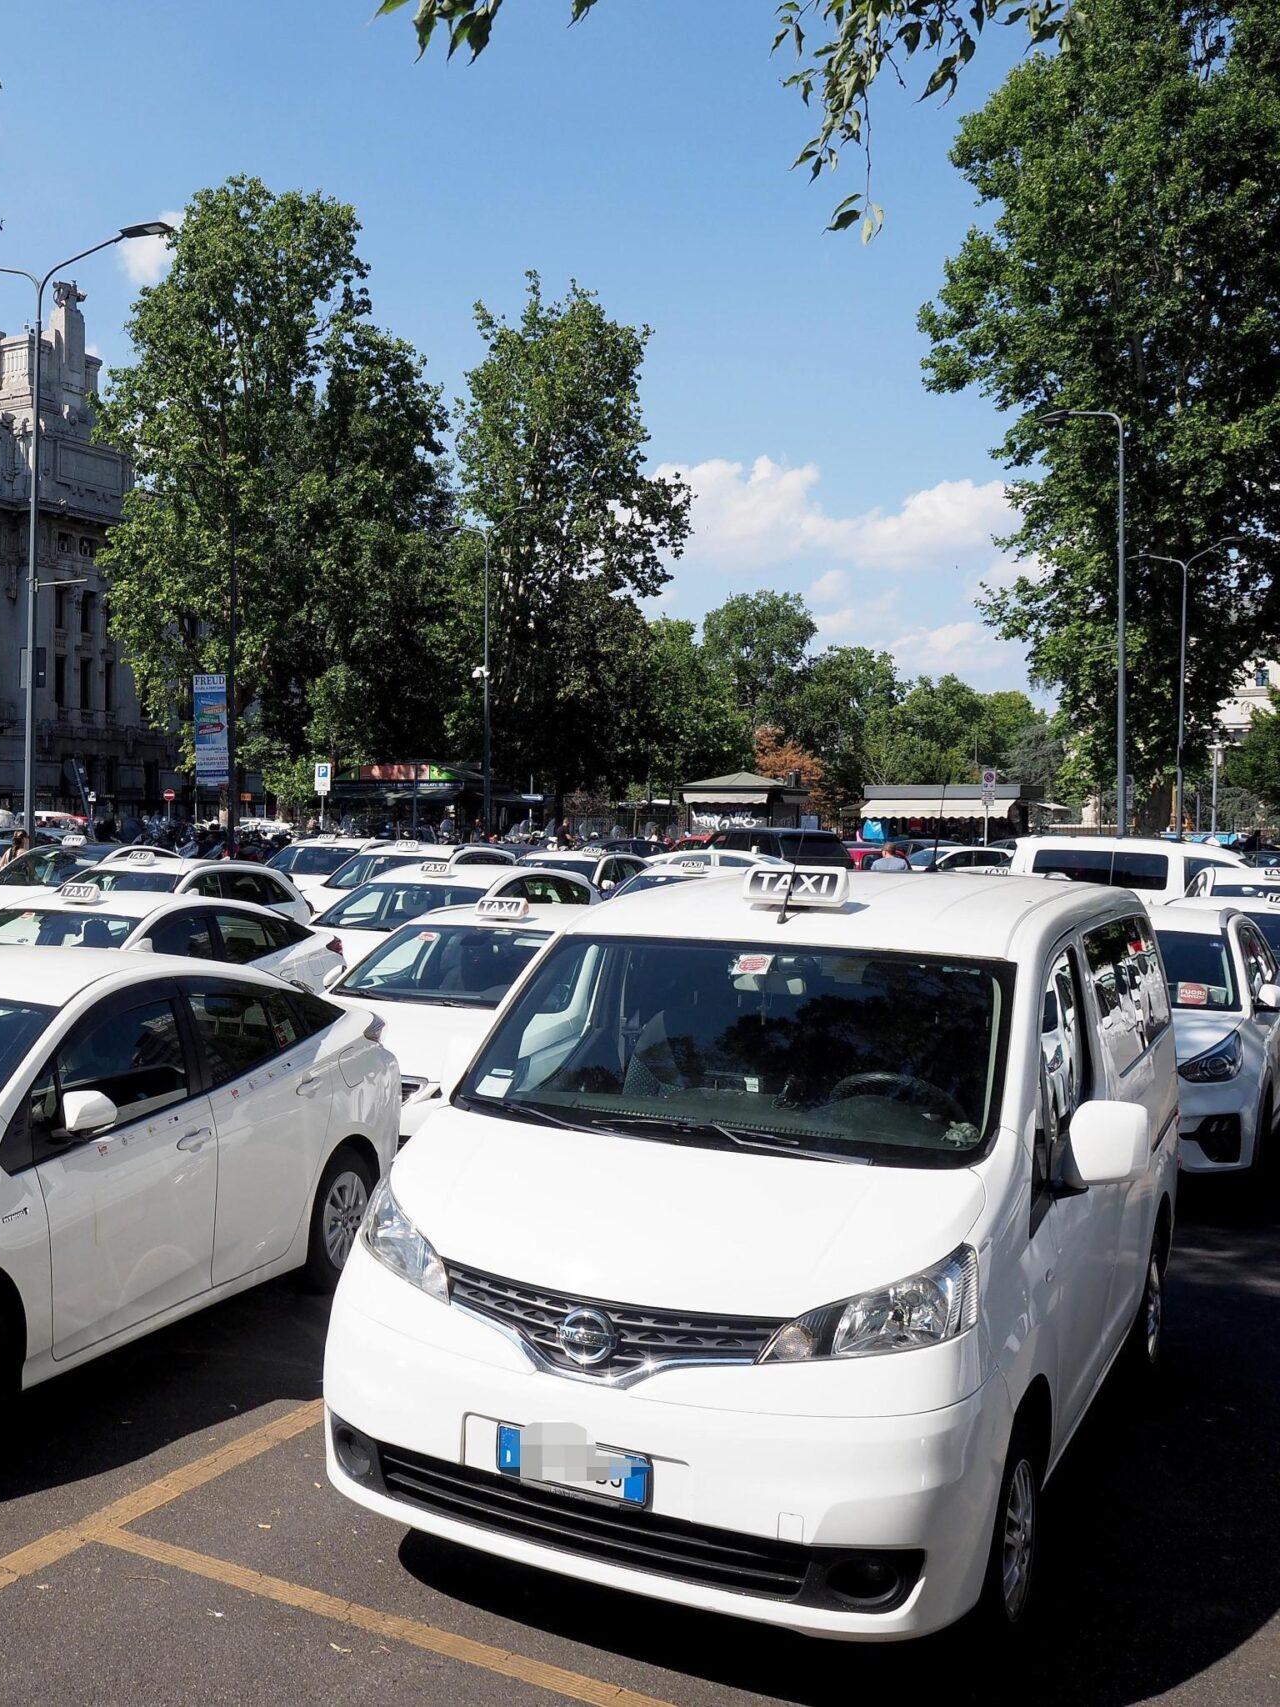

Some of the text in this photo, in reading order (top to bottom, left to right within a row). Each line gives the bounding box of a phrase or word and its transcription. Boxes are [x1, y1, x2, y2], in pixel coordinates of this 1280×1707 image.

[195, 676, 225, 685] FREUD
[423, 864, 446, 872] TAXI
[758, 873, 829, 893] TAXI
[64, 887, 91, 897] TAXI
[482, 902, 517, 912] TAXI
